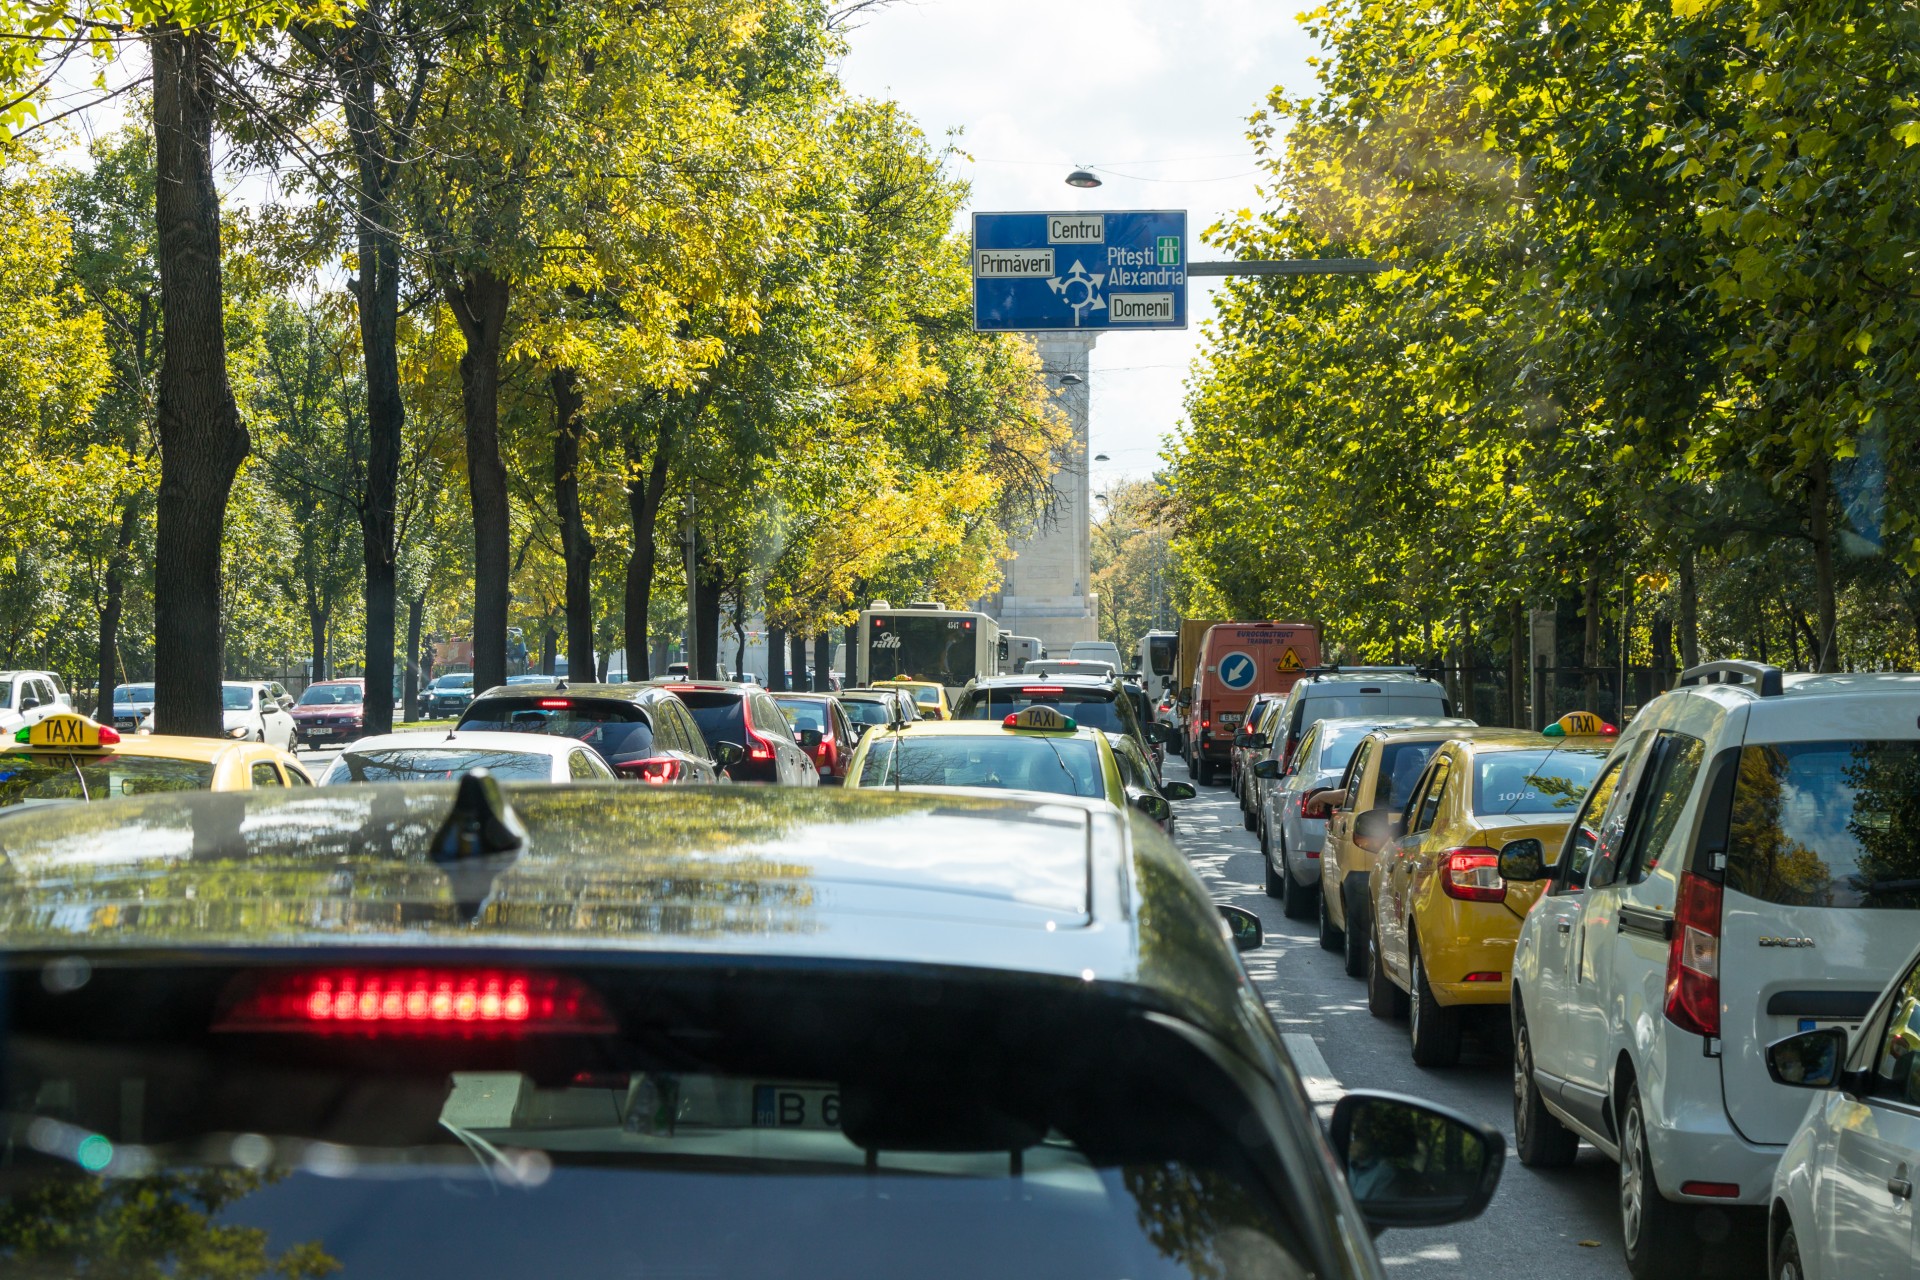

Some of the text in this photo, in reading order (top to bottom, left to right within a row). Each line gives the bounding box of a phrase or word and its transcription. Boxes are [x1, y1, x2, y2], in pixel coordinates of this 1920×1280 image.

[1052, 220, 1101, 239] Centru
[981, 253, 1051, 273] Primăverii
[1107, 247, 1154, 269] Pitești
[1108, 267, 1184, 286] Alexandria
[1113, 298, 1170, 317] Domenii
[1236, 630, 1294, 638] EUROCONSTRUCT
[1027, 710, 1055, 728] TAXI
[1568, 715, 1595, 733] TAXI
[44, 719, 84, 743] TAXI
[1498, 791, 1536, 802] 1008
[1759, 936, 1816, 949] DACIA
[779, 1093, 806, 1125] B
